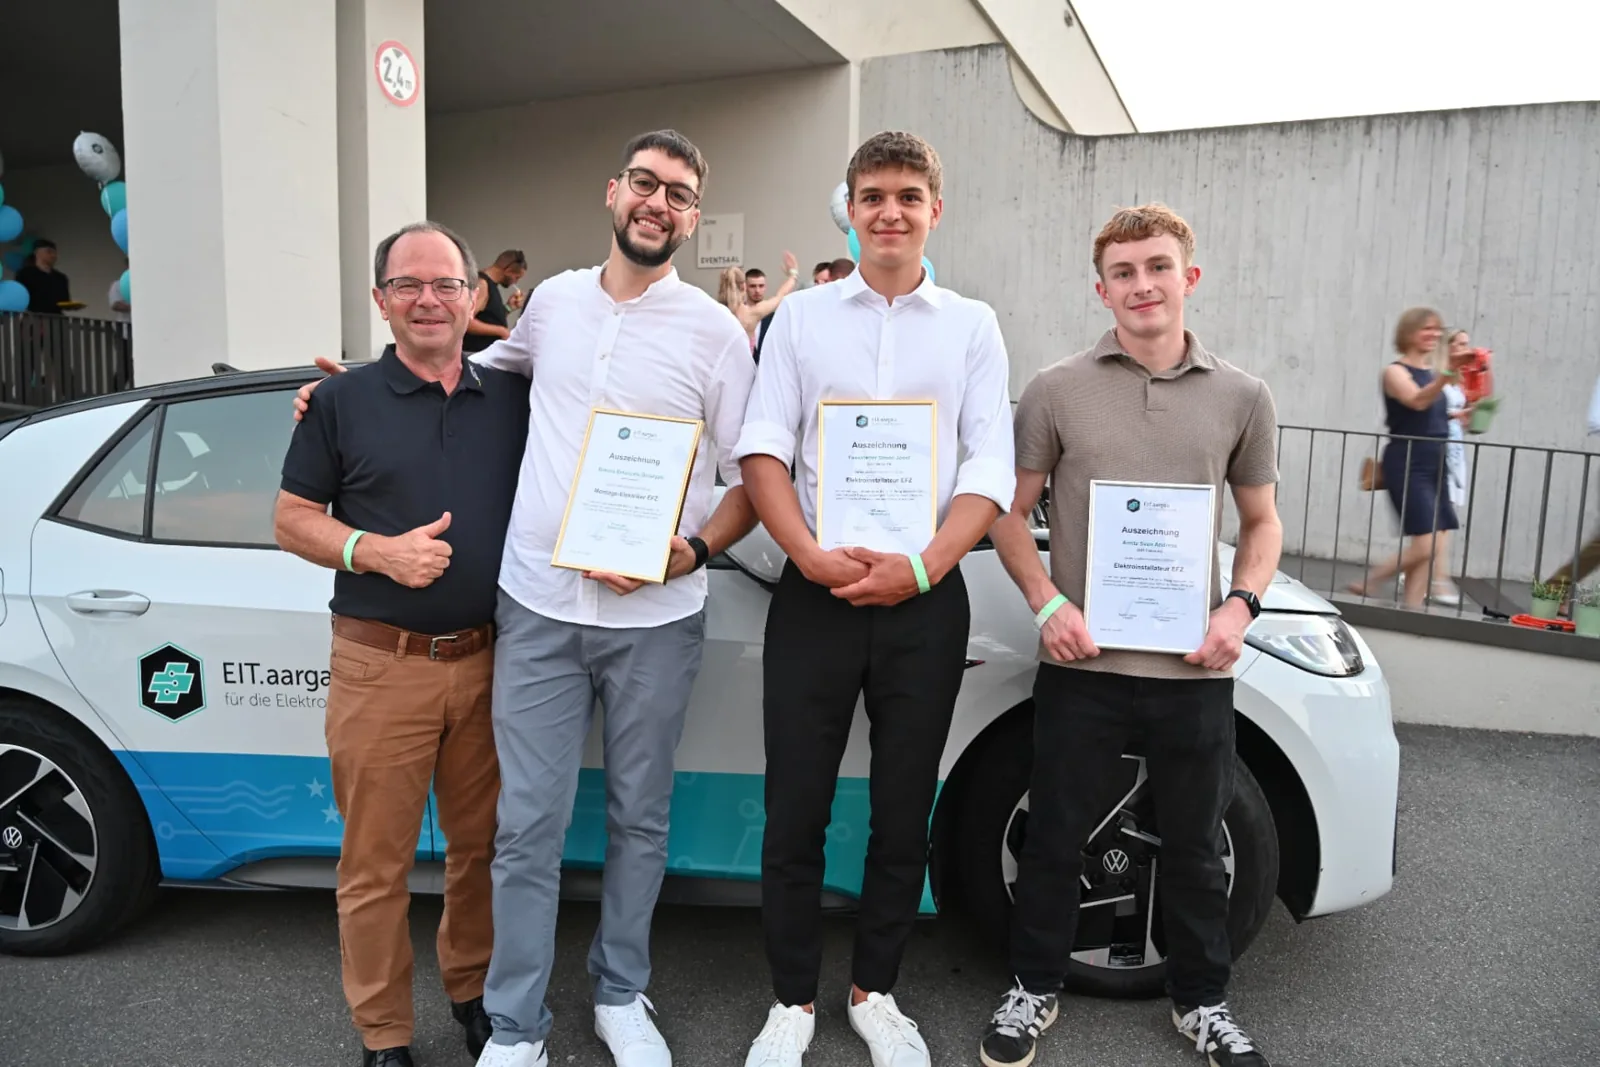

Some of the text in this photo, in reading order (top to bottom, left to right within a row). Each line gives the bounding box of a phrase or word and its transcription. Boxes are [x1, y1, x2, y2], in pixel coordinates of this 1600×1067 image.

[700, 256, 740, 264] EVENTSAAL
[852, 441, 907, 450] Auszeichnung
[609, 452, 661, 466] Auszeichnung
[1121, 526, 1180, 538] Auszeichnung
[1113, 562, 1170, 572] Elektroinstallateur
[225, 692, 327, 708] für die Elektro
